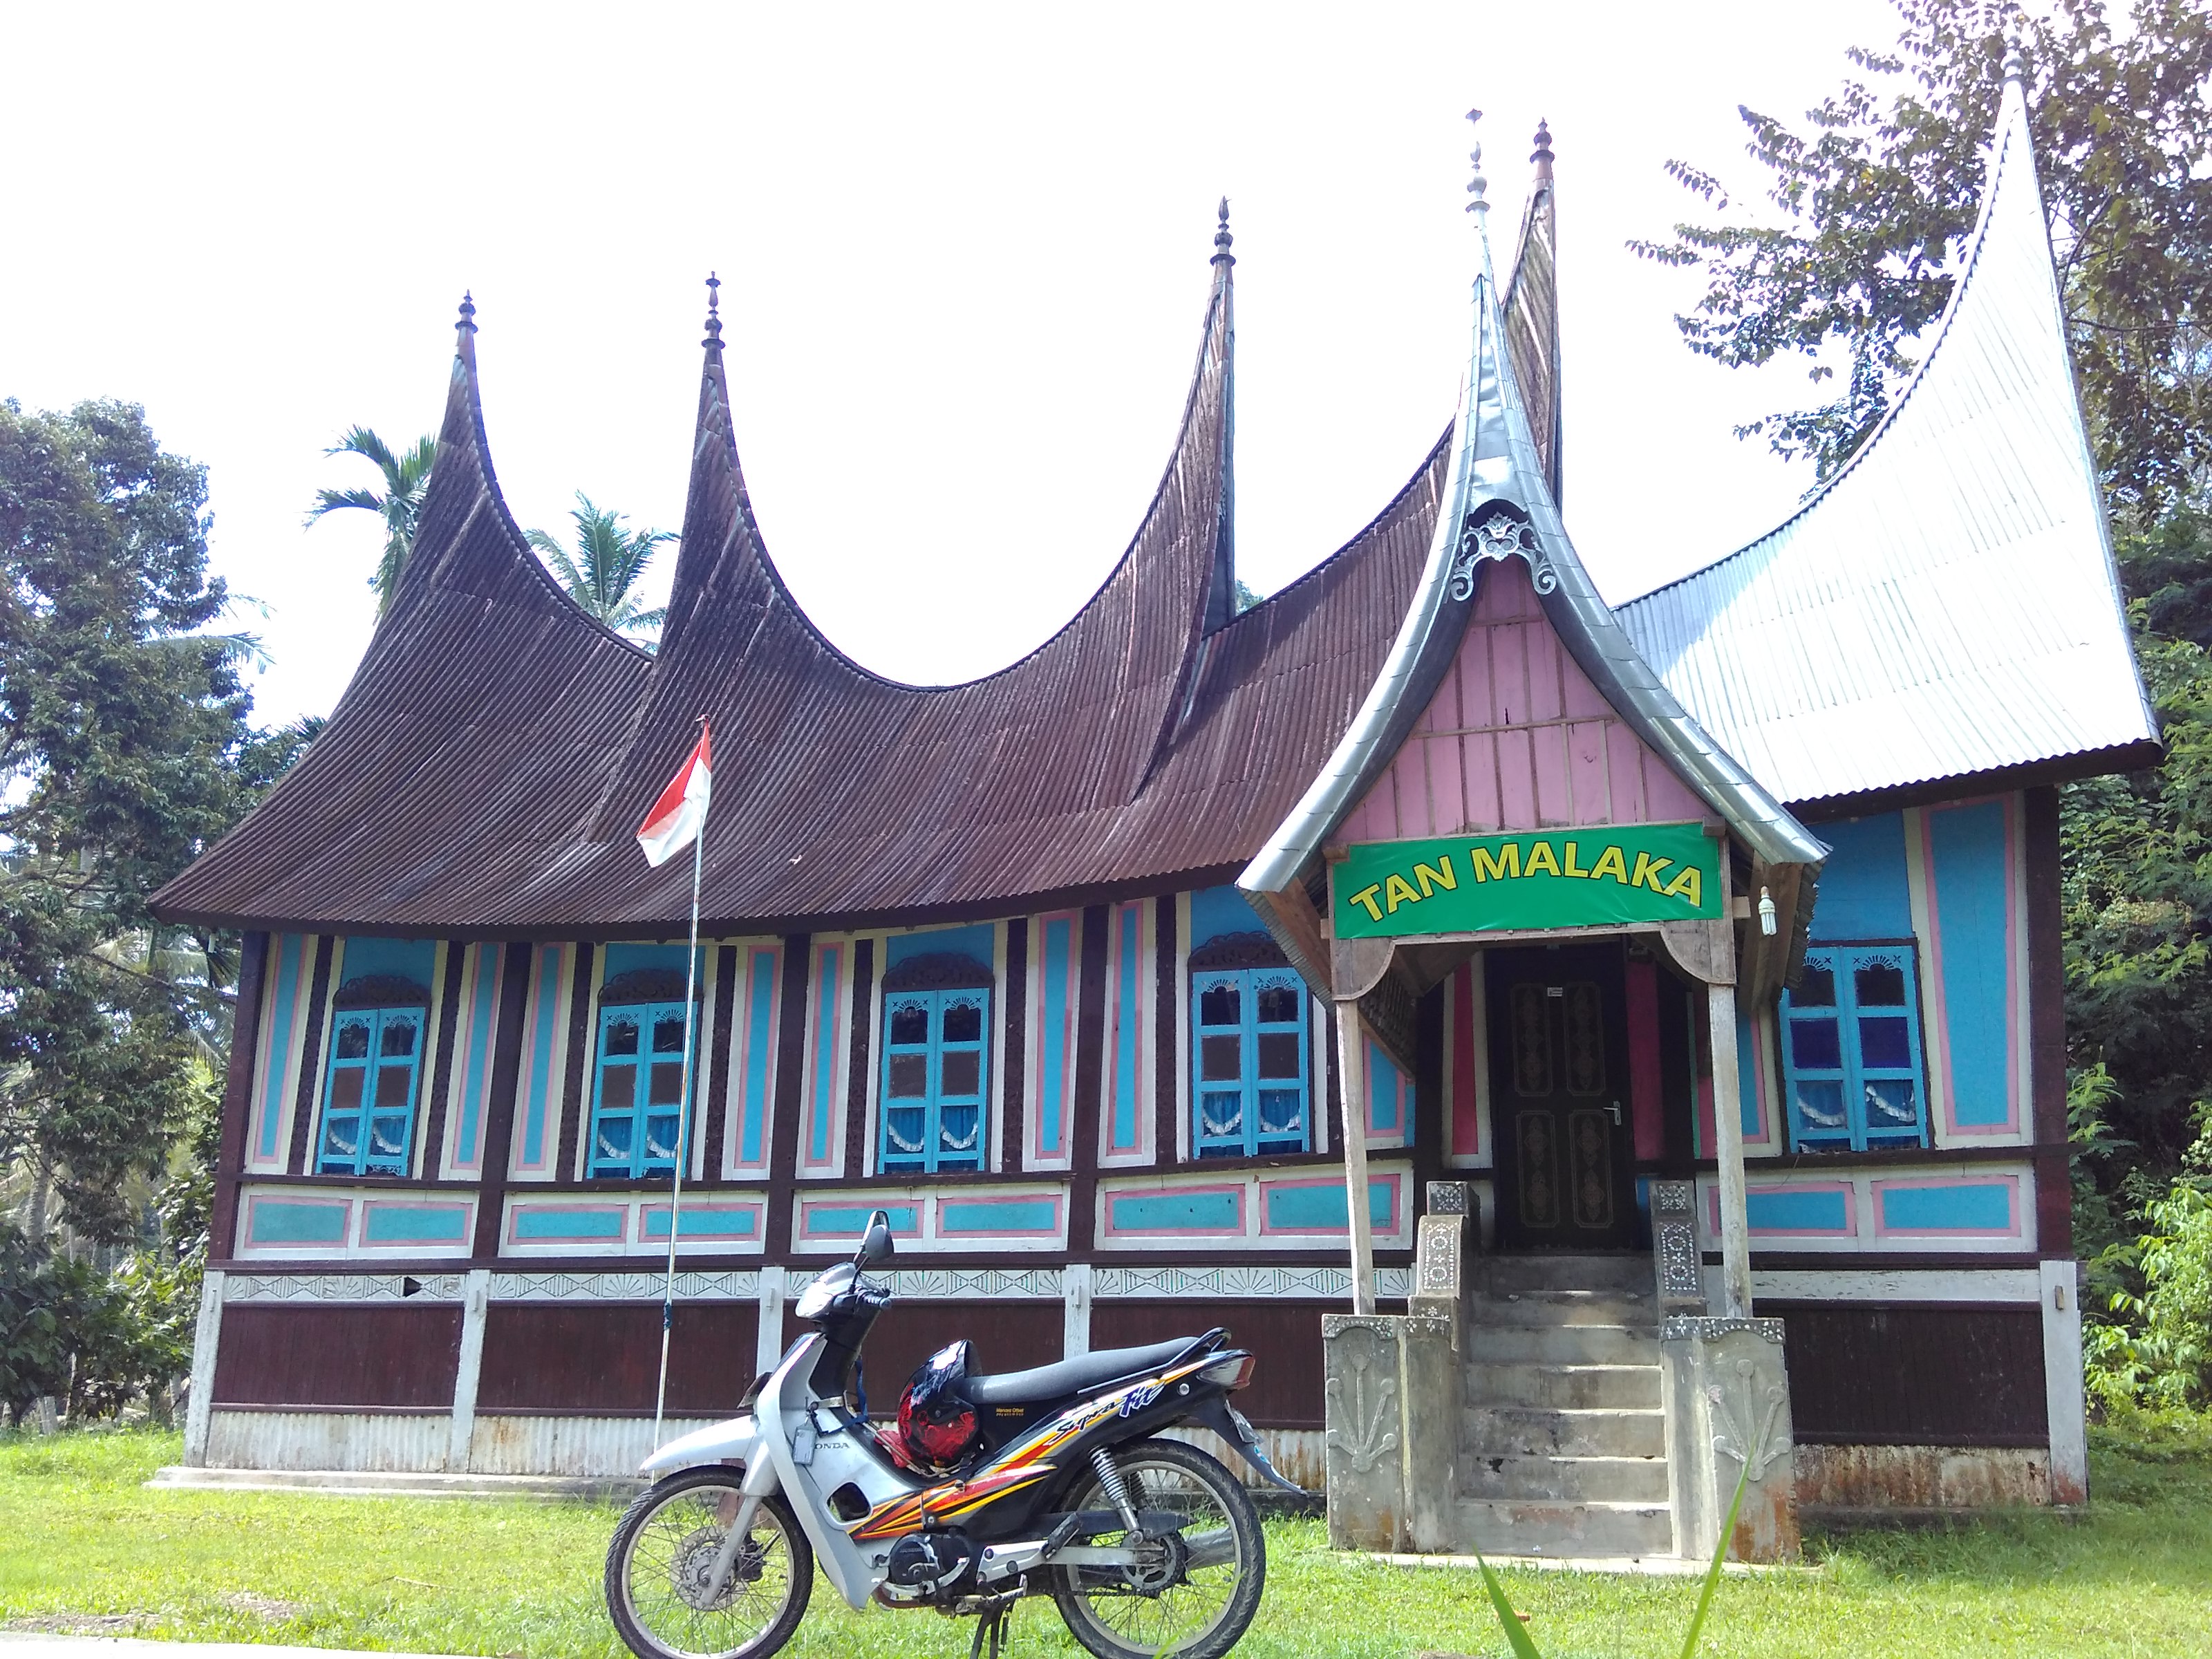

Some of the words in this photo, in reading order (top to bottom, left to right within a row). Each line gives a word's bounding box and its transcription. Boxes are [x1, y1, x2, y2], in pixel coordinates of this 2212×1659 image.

[1349, 855, 1458, 921] TAN
[1470, 841, 1702, 908] MALAKA
[1044, 1398, 1124, 1445] Supra
[1119, 1381, 1165, 1418] Fit
